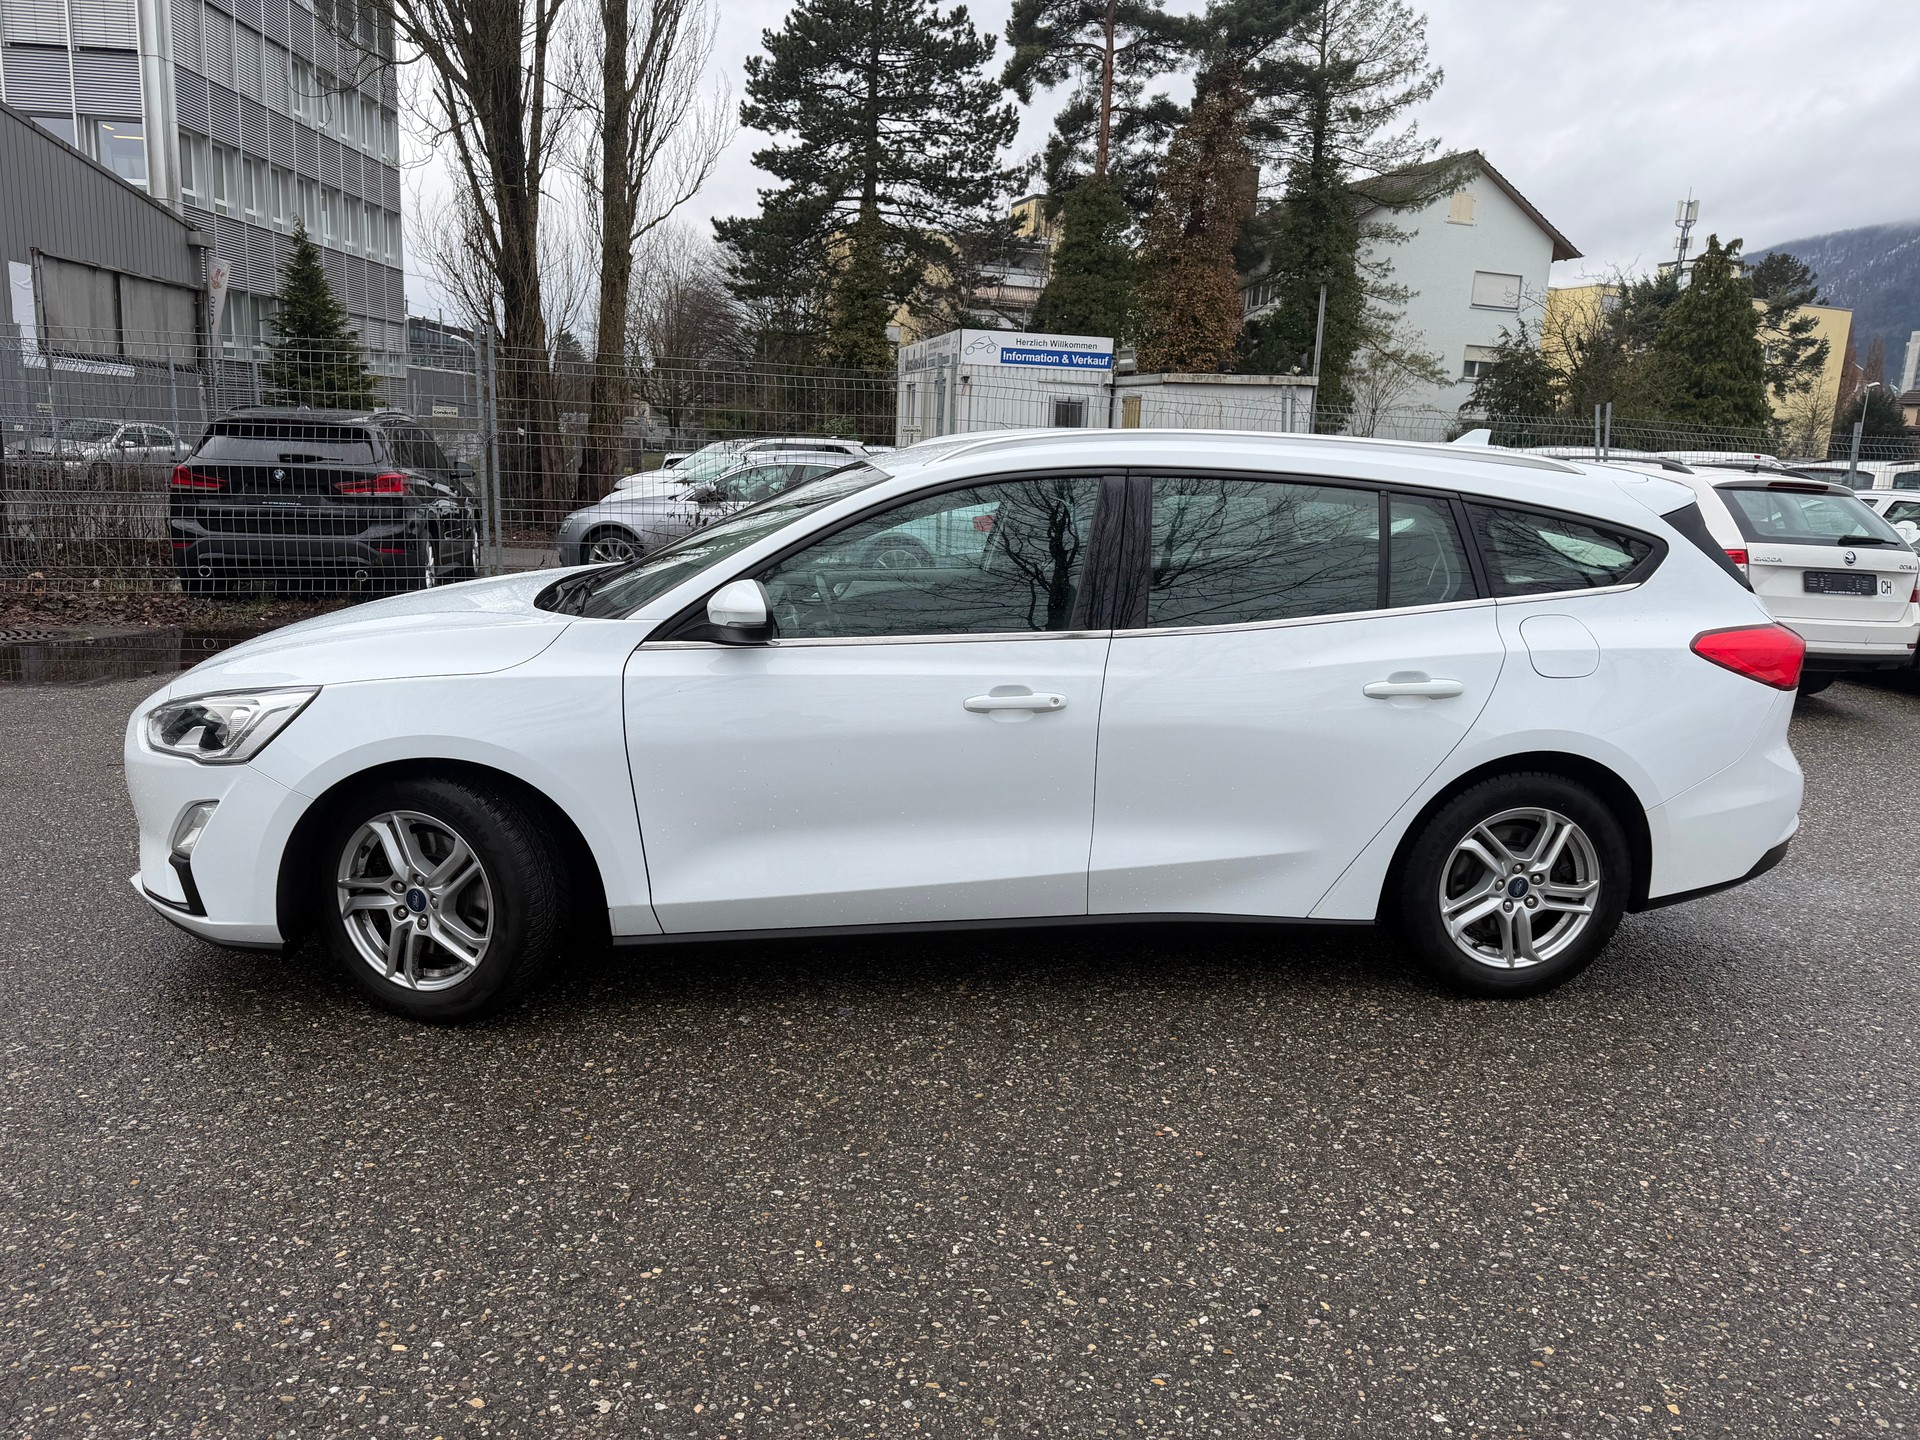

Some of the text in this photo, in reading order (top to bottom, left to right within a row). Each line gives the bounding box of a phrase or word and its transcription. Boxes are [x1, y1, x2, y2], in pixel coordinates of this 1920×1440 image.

[1016, 338, 1098, 350] Herzlich Willkommen
[1003, 351, 1109, 366] Information & Verkauf
[1881, 580, 1892, 595] CH
